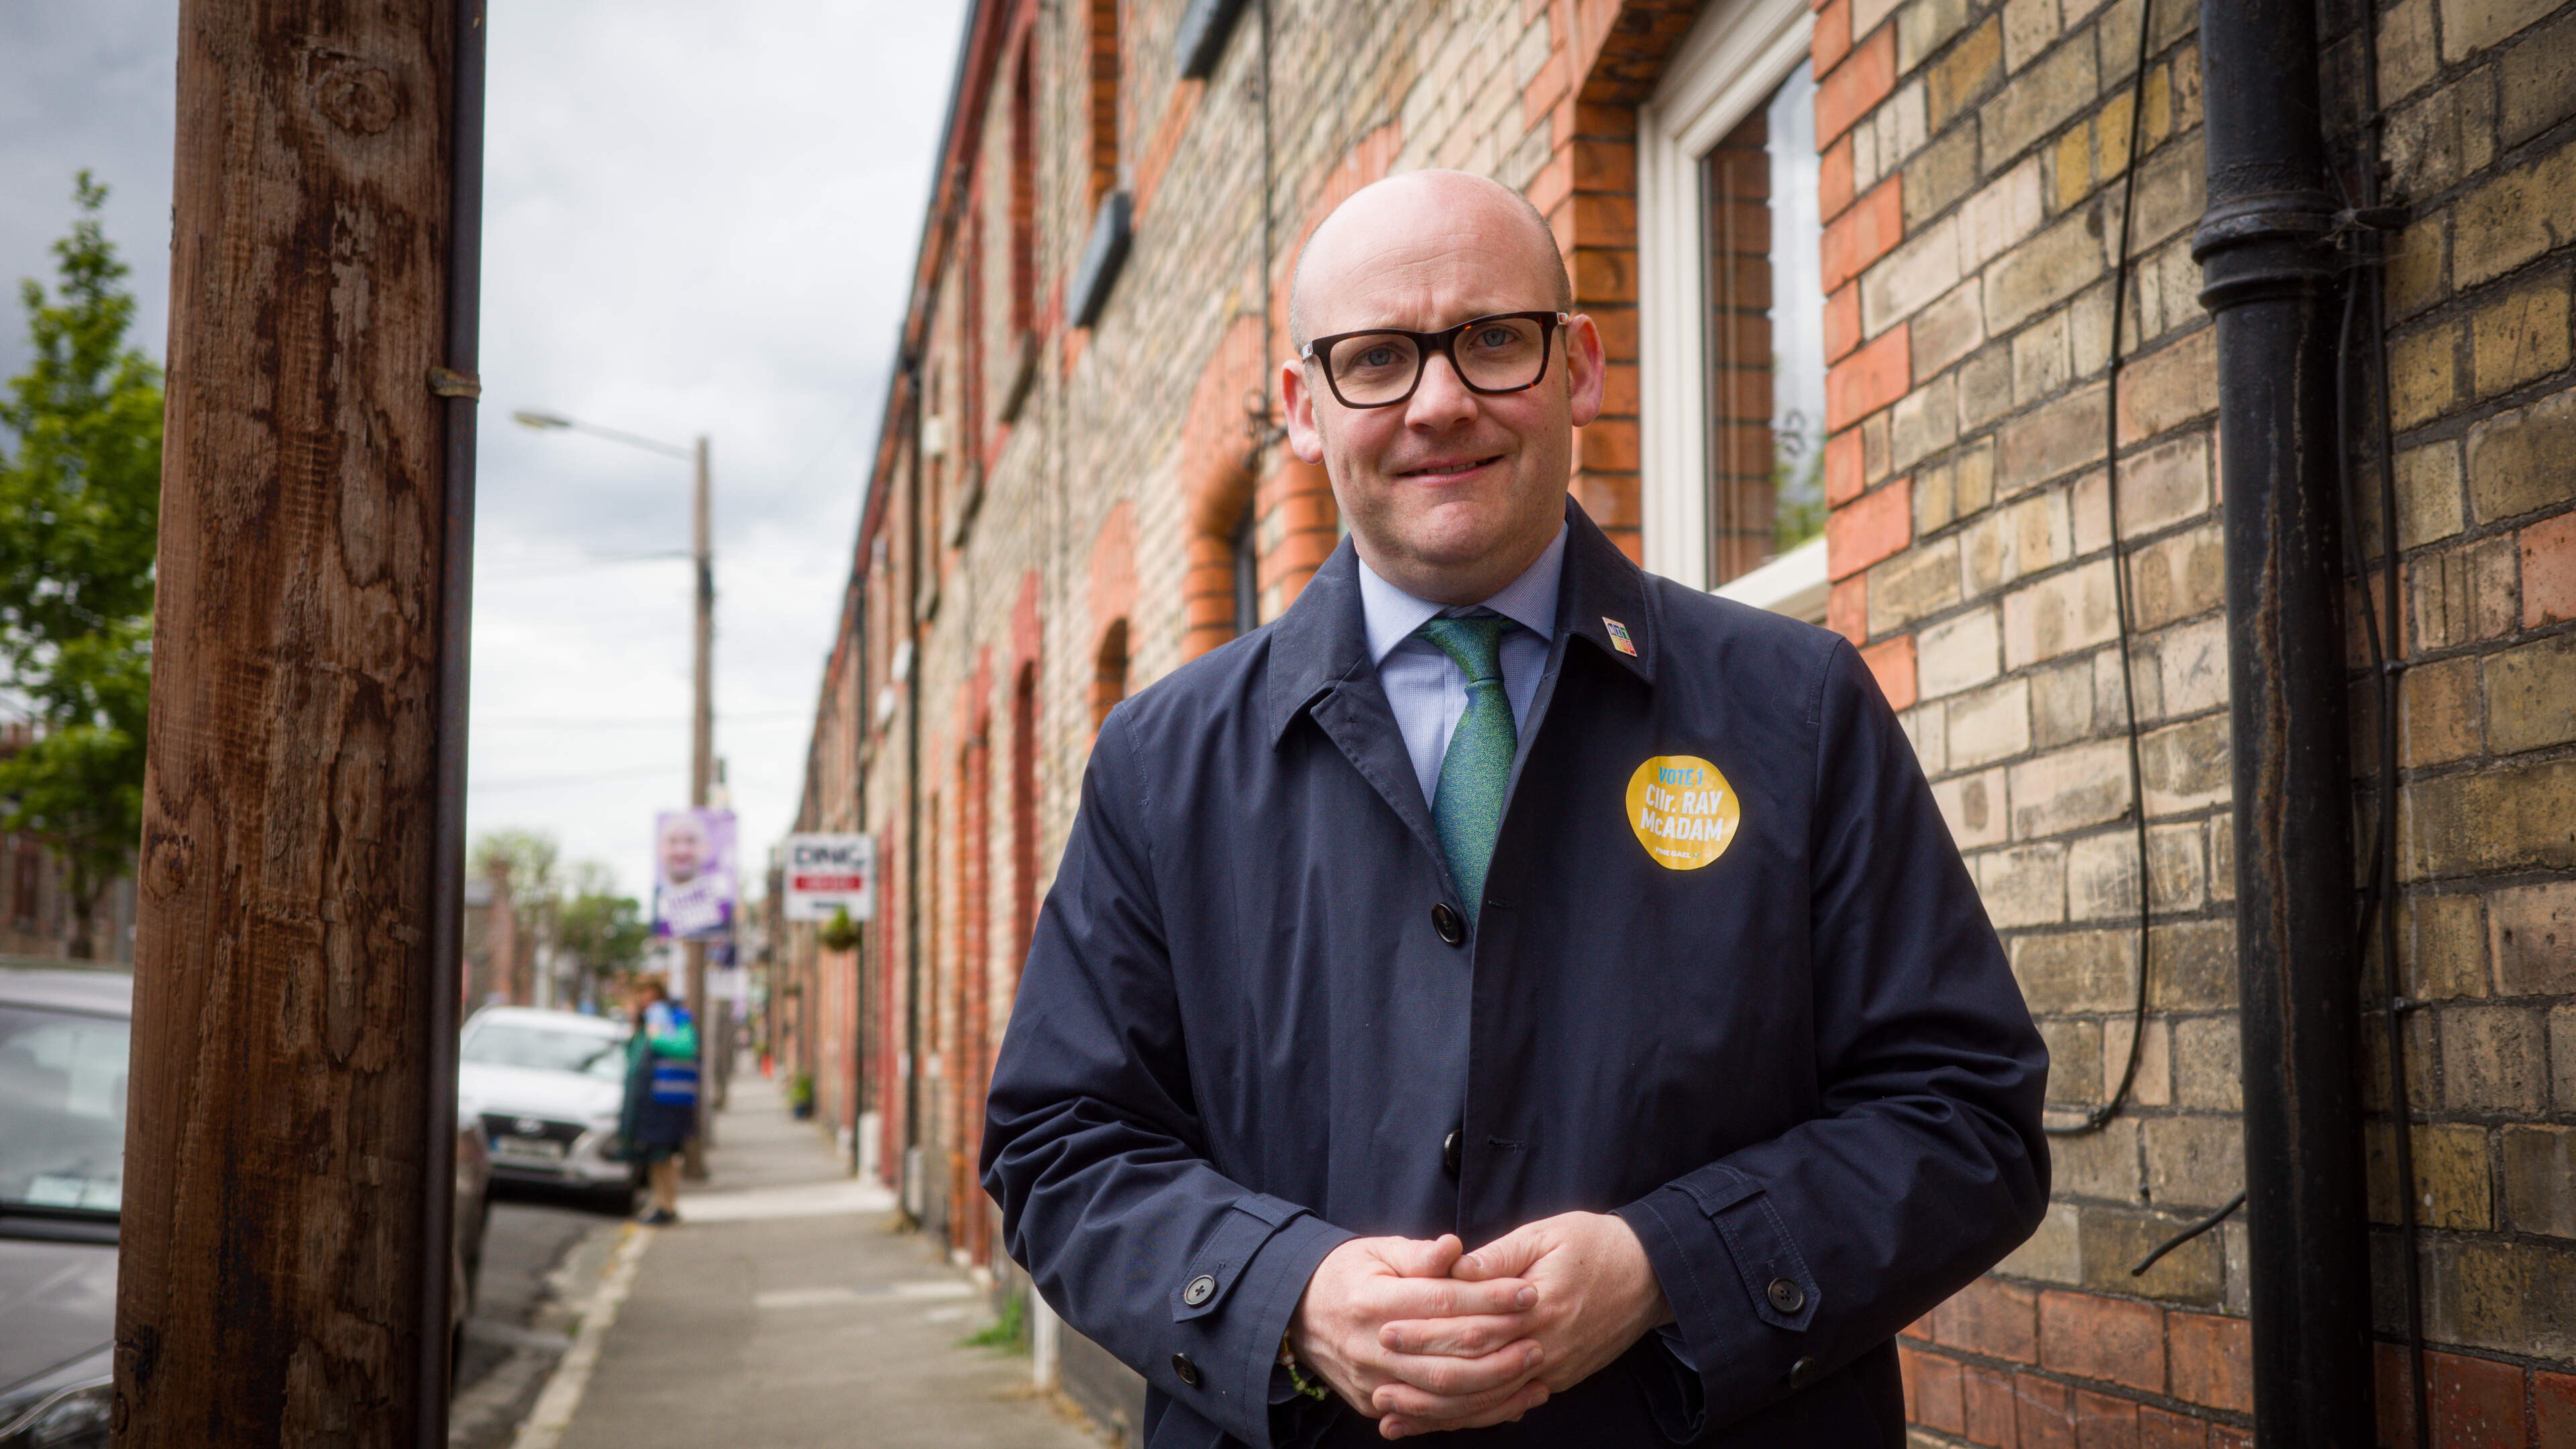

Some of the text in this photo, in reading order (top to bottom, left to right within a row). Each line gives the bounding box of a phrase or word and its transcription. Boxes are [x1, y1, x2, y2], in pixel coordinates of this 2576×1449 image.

[1659, 766, 1703, 786] VOTE 1
[1646, 784, 1723, 814] Cllr. RAY
[1640, 807, 1723, 841] McADAM
[1671, 850, 1691, 859] GAEL
